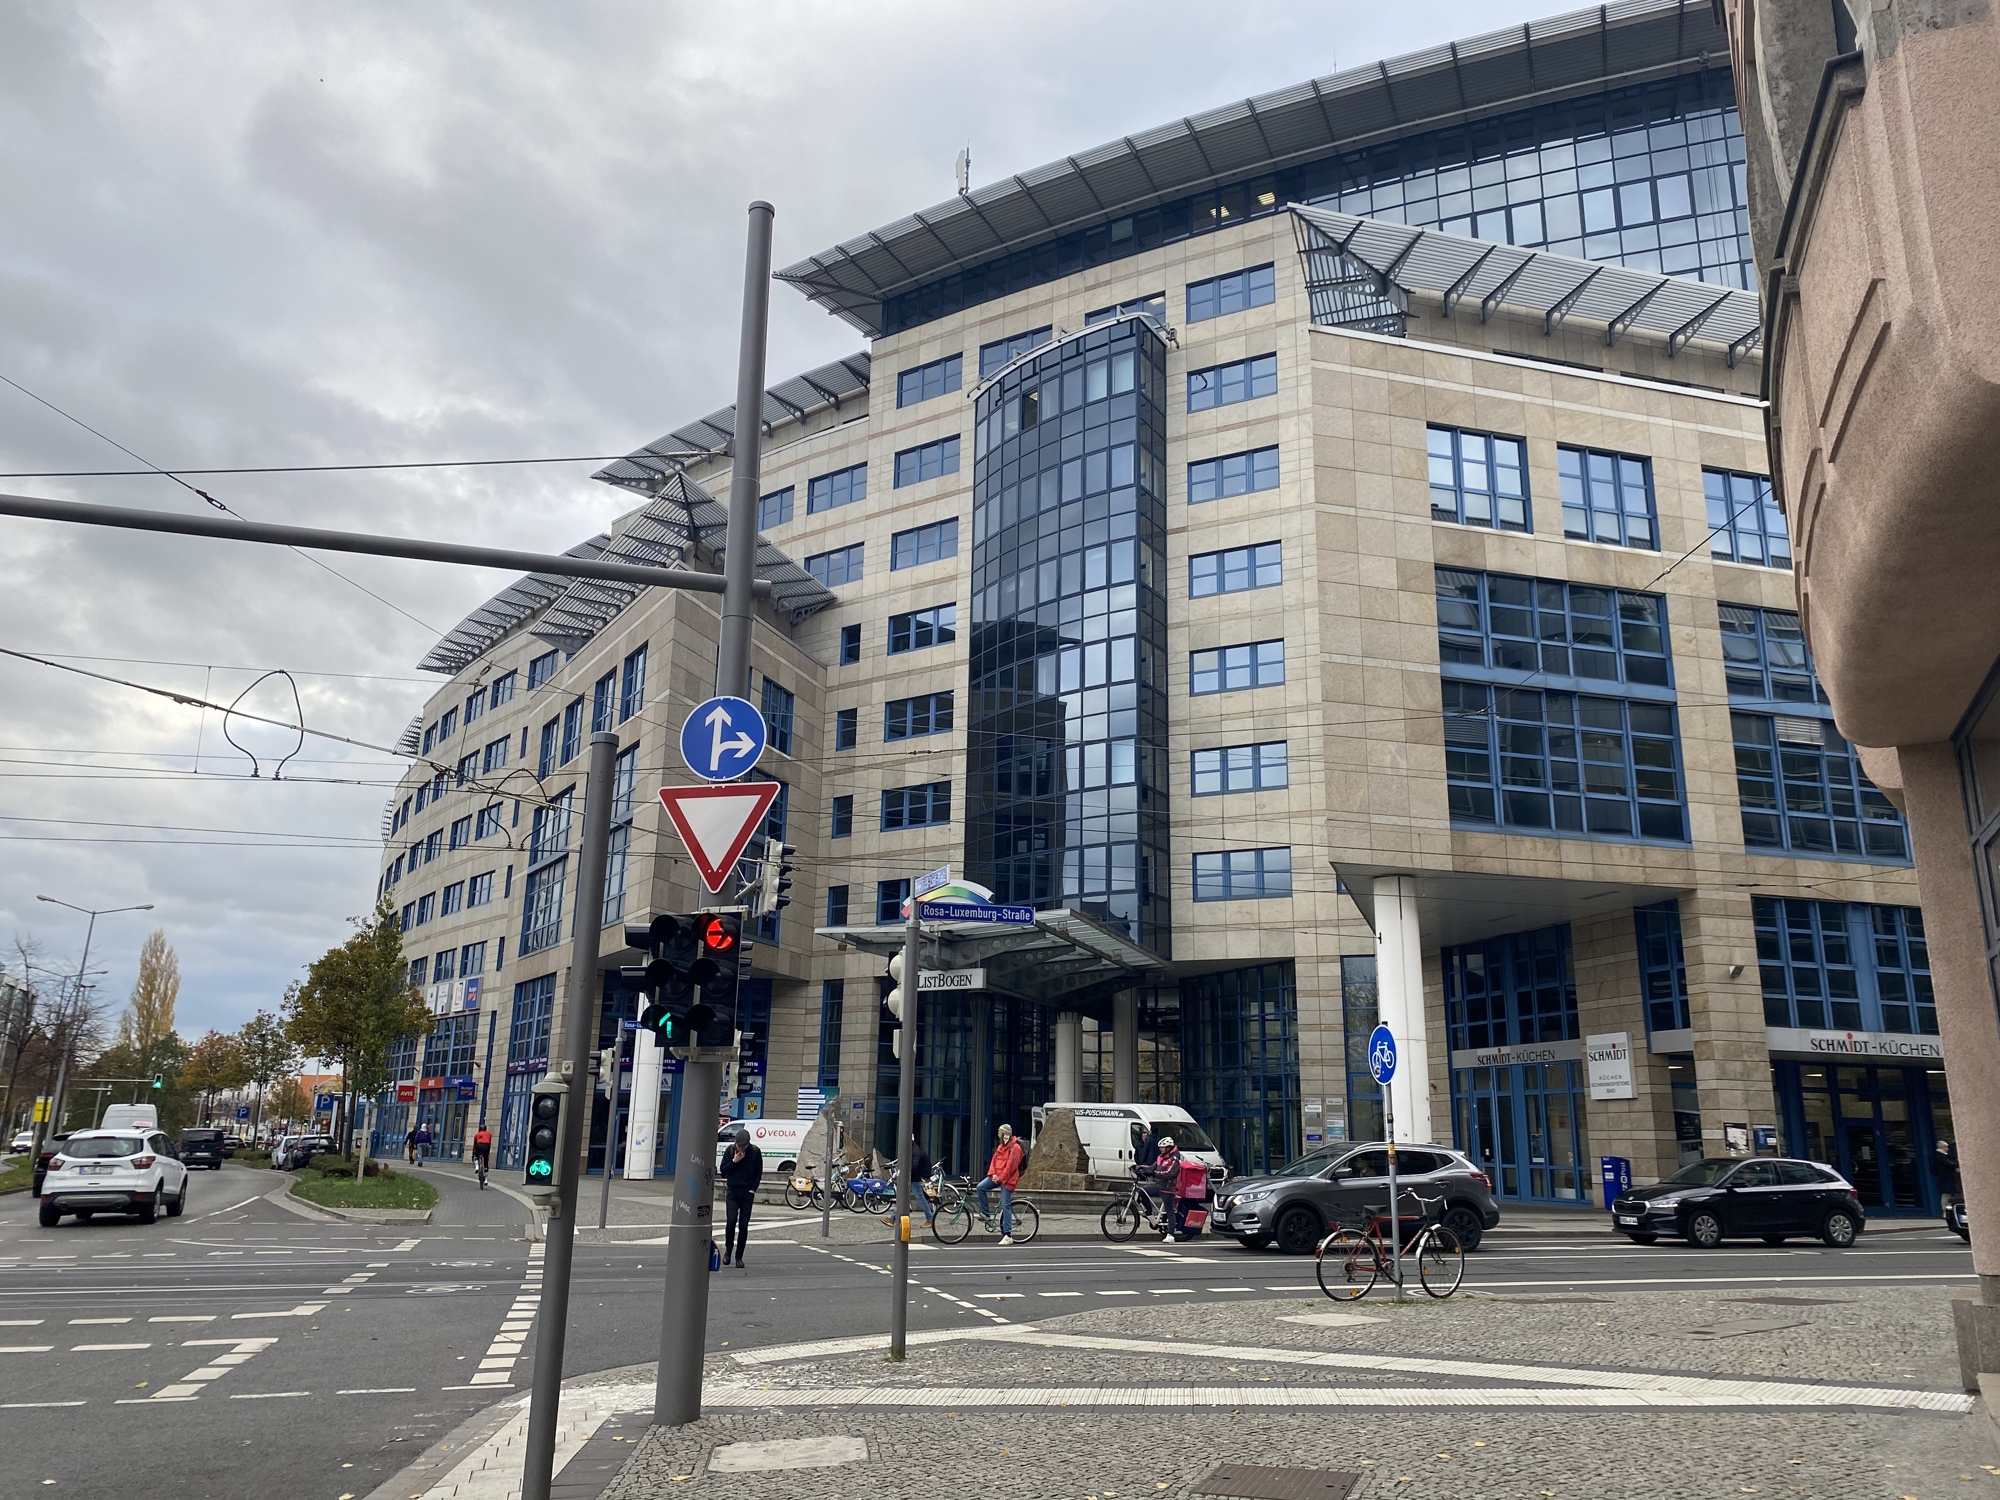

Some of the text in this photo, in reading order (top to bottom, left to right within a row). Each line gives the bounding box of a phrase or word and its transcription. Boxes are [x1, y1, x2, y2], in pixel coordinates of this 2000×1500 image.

[924, 905, 1030, 921] Rosa-Luxemburg-Straße
[320, 1096, 330, 1108] P
[240, 1108, 247, 1117] P
